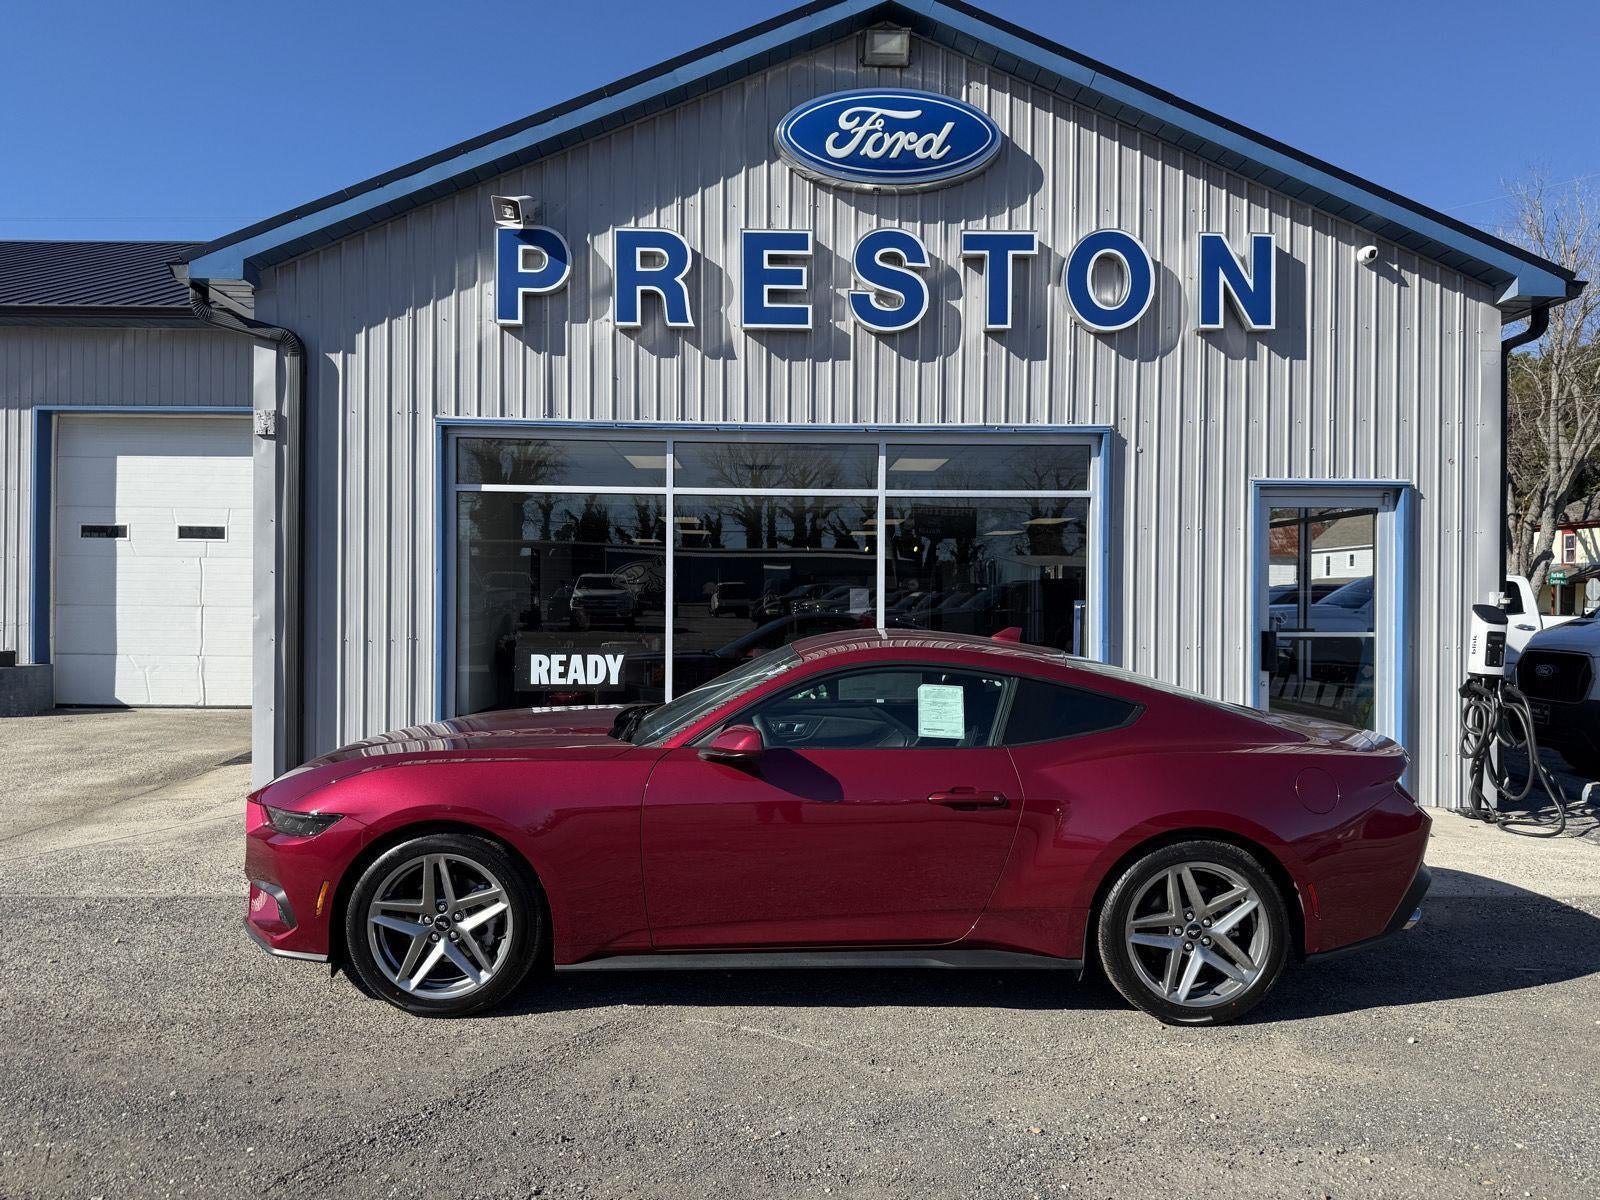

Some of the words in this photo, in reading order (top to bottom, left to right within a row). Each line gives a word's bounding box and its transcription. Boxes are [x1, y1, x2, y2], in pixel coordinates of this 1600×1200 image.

[825, 106, 955, 160] Ford
[495, 225, 1276, 331] PRESTON
[530, 653, 625, 685] READY
